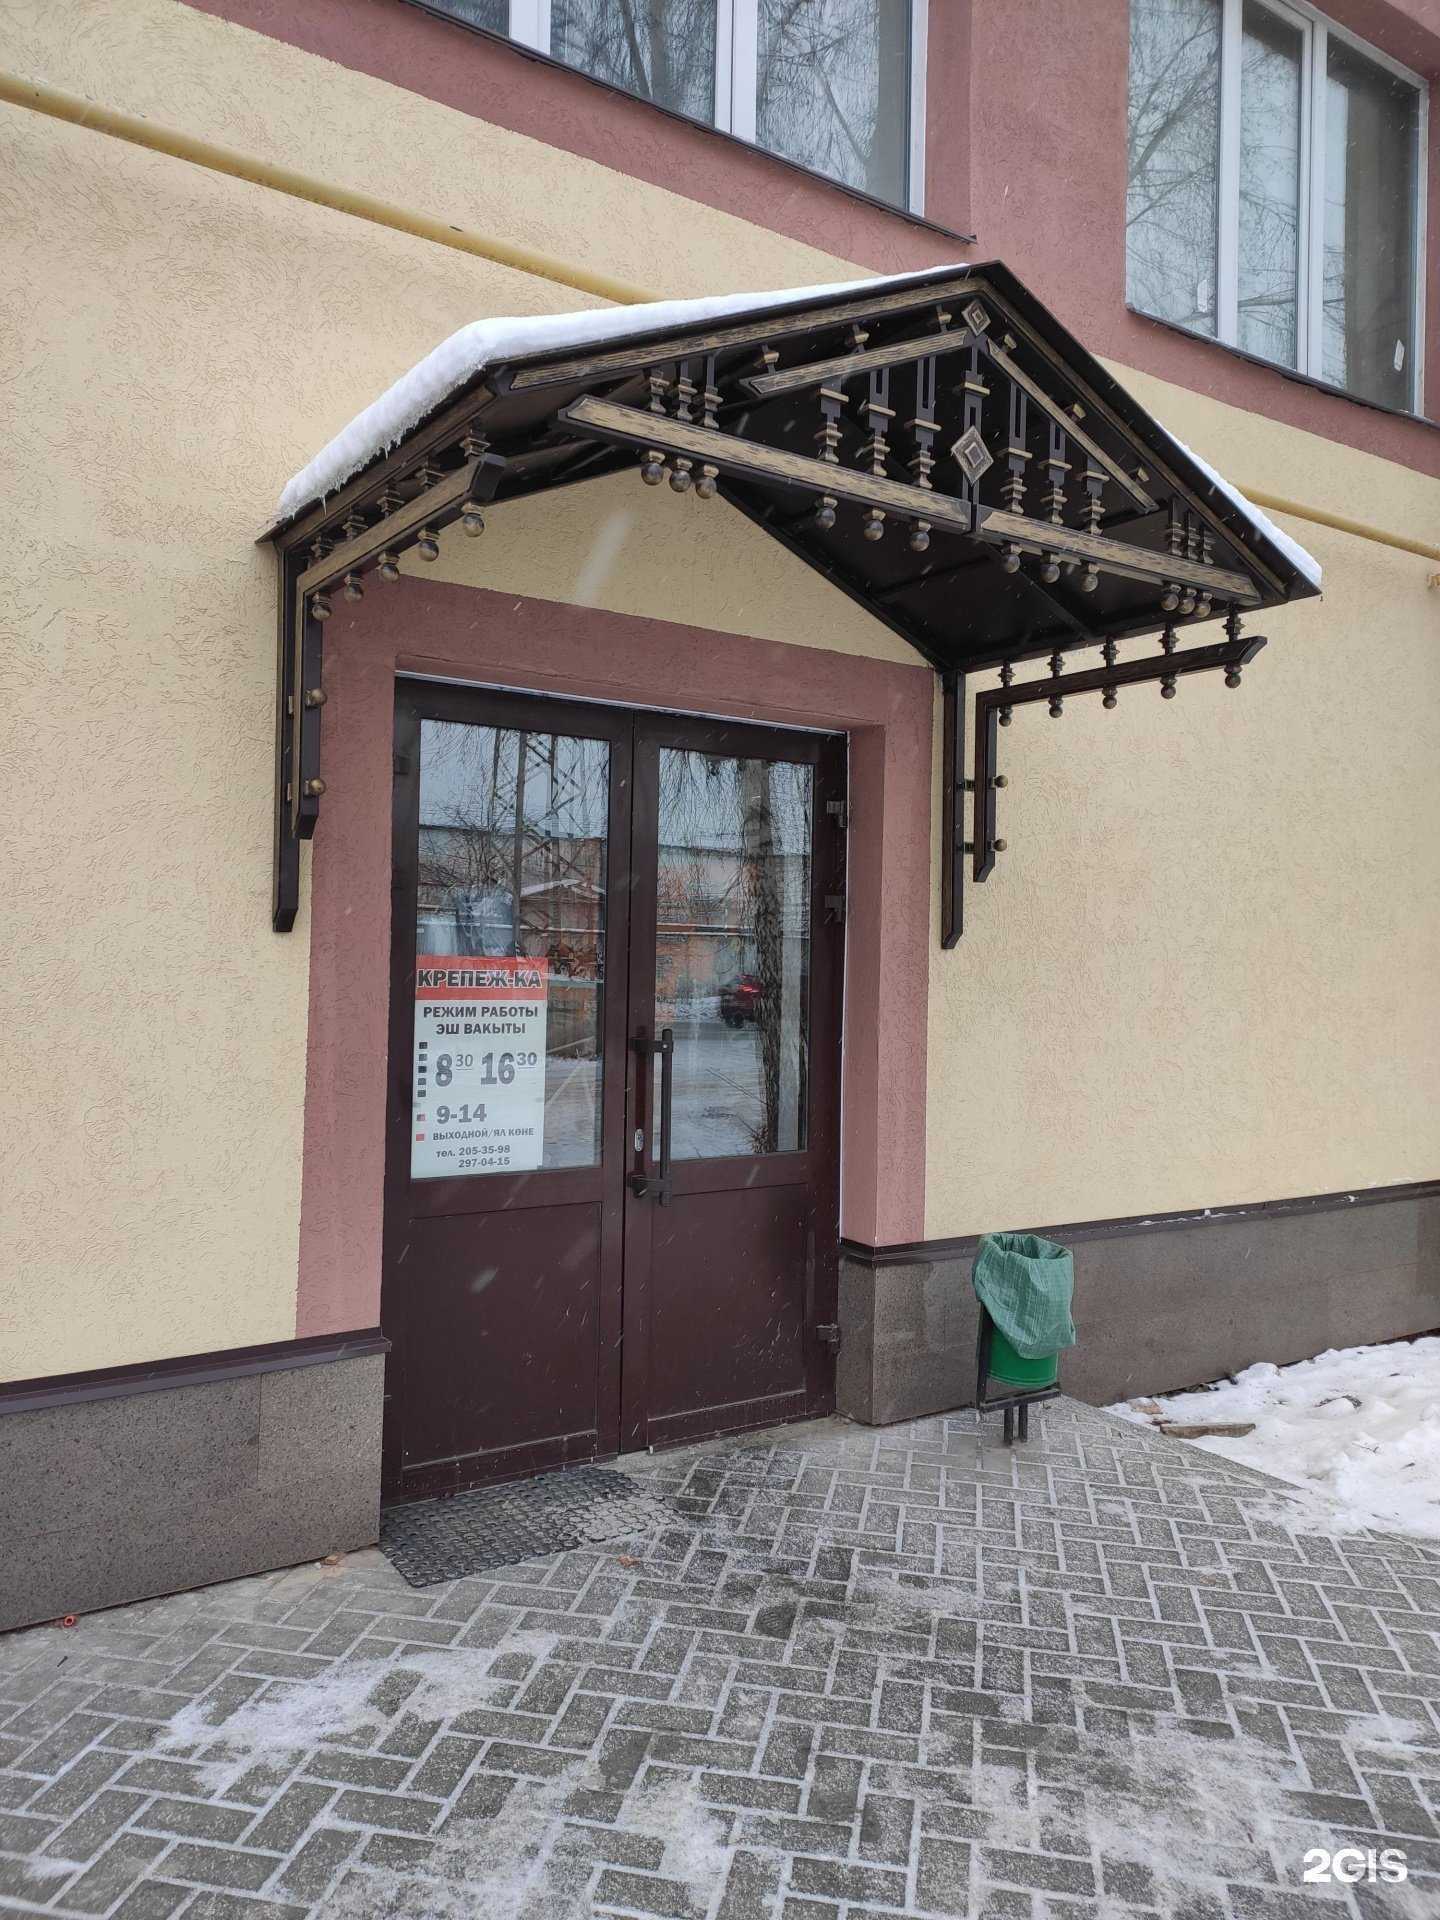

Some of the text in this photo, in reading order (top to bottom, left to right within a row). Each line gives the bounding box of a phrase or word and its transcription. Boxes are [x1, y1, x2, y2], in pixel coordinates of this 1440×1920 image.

[417, 969, 543, 989] КРЕПЕЖ-КА
[423, 1006, 538, 1018] РЕЖИМ РАБОТЫ
[435, 1023, 526, 1035] ЭШ ВАКЫТЫ
[436, 1104, 488, 1124] 9-14
